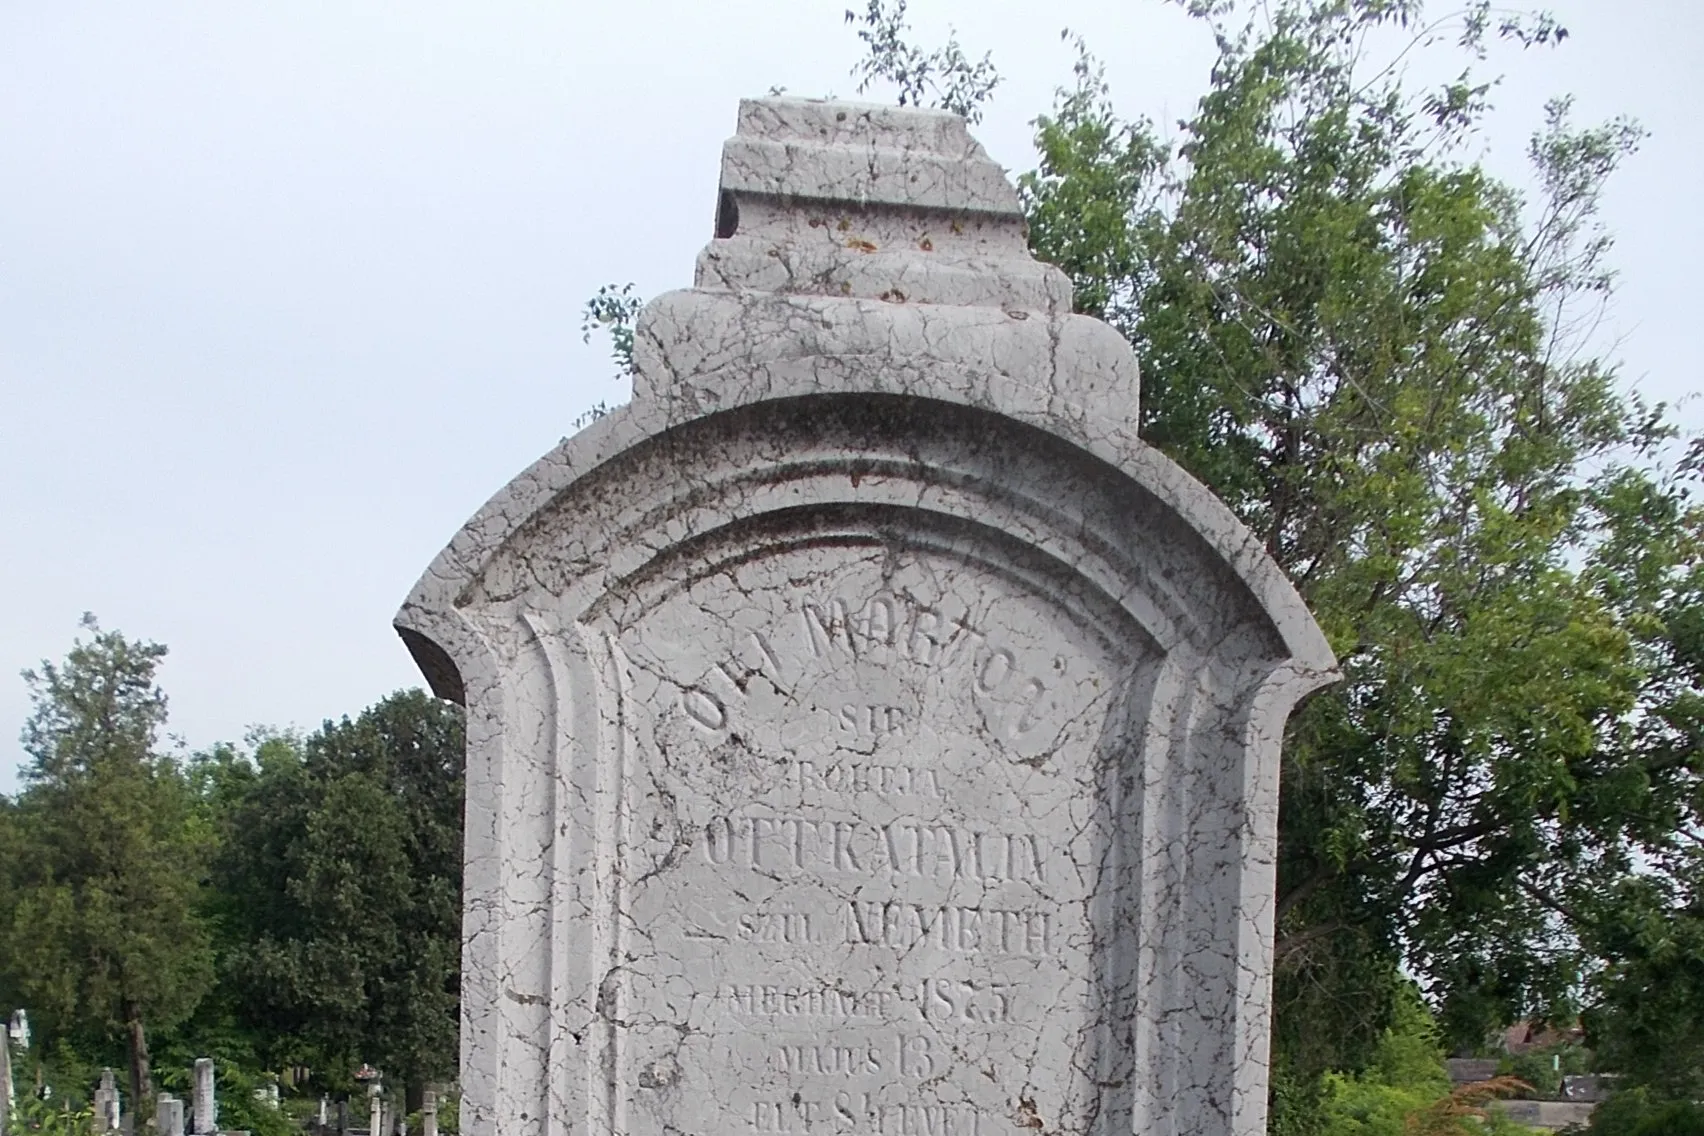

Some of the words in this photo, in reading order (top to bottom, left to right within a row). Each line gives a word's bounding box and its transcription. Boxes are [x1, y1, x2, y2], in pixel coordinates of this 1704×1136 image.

[702, 815, 820, 870] OTT
[828, 822, 1048, 886] KATALIN
[722, 984, 898, 1016] MEGHALT
[895, 1032, 936, 1078] 13
